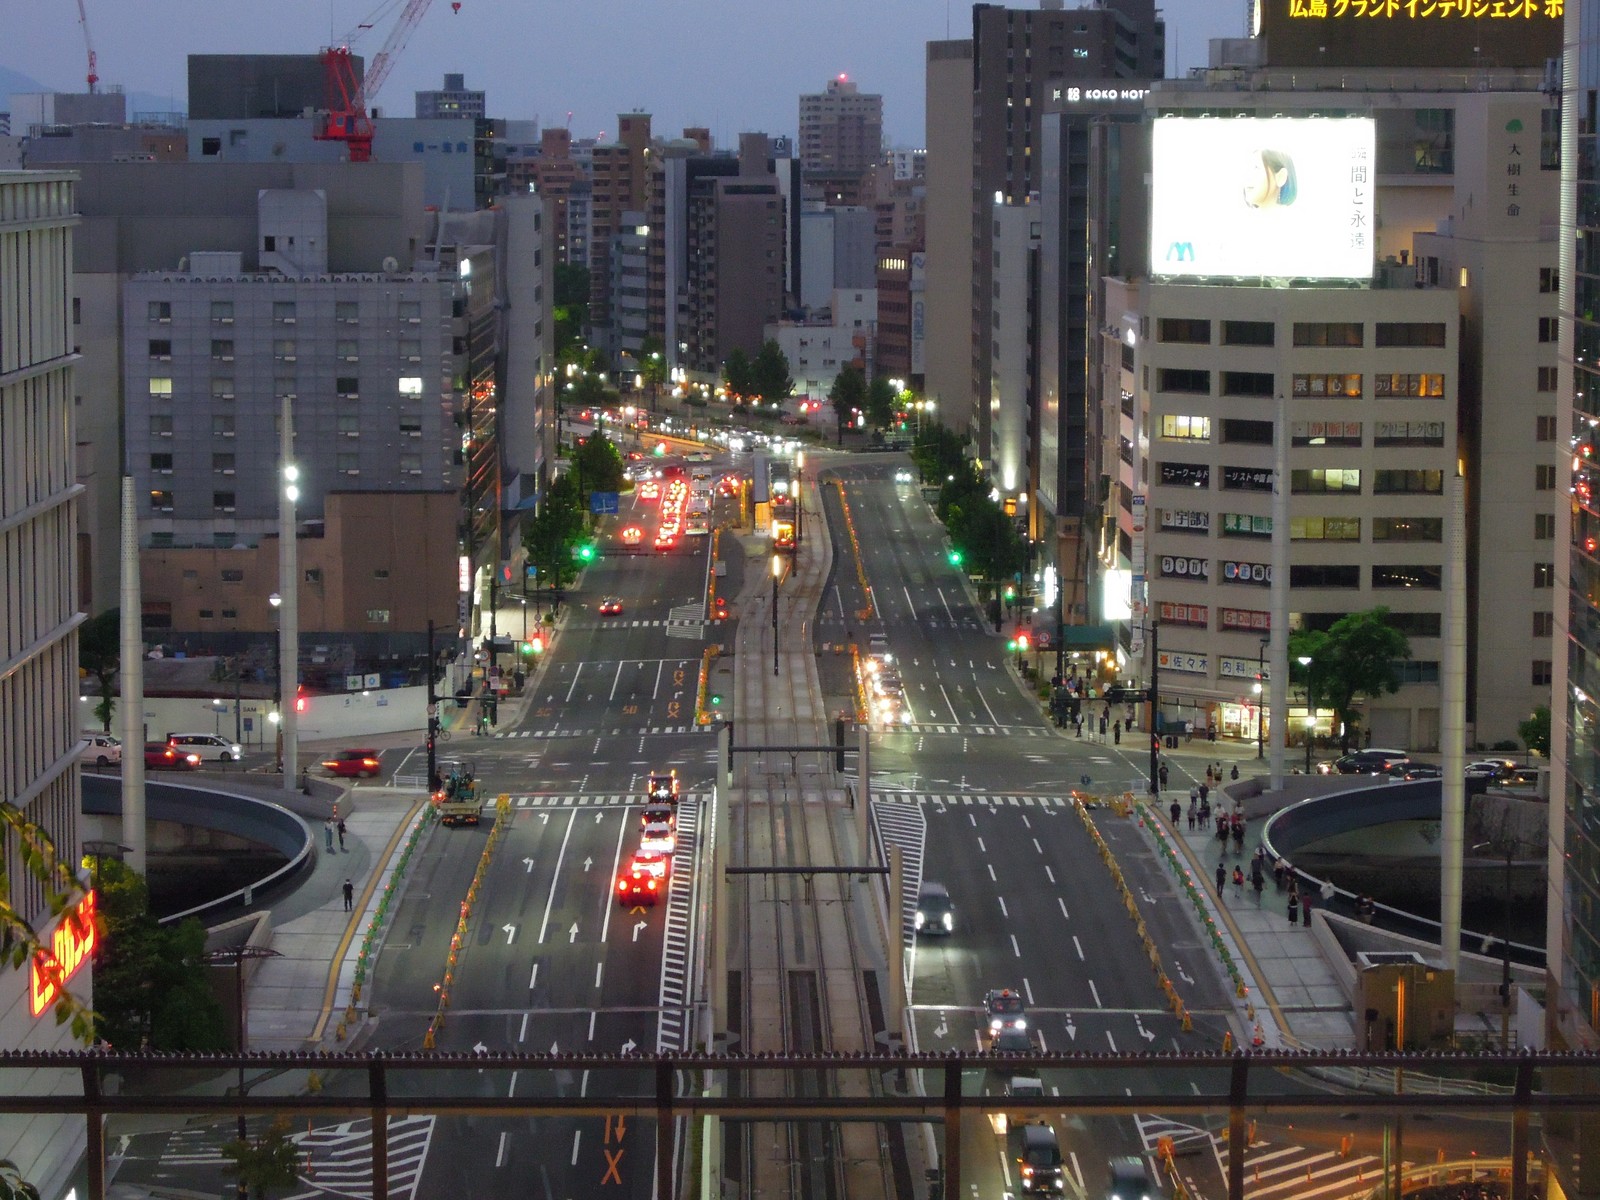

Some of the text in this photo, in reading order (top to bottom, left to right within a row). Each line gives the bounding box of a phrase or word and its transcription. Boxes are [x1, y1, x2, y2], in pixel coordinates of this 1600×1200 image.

[1288, 0, 1327, 18] 広島
[1086, 90, 1118, 99] KOKO
[1507, 143, 1521, 217] 大樹生命
[1294, 379, 1361, 392] 京橋心
[1173, 656, 1207, 669] 佐々木
[1222, 661, 1245, 673] 内科
